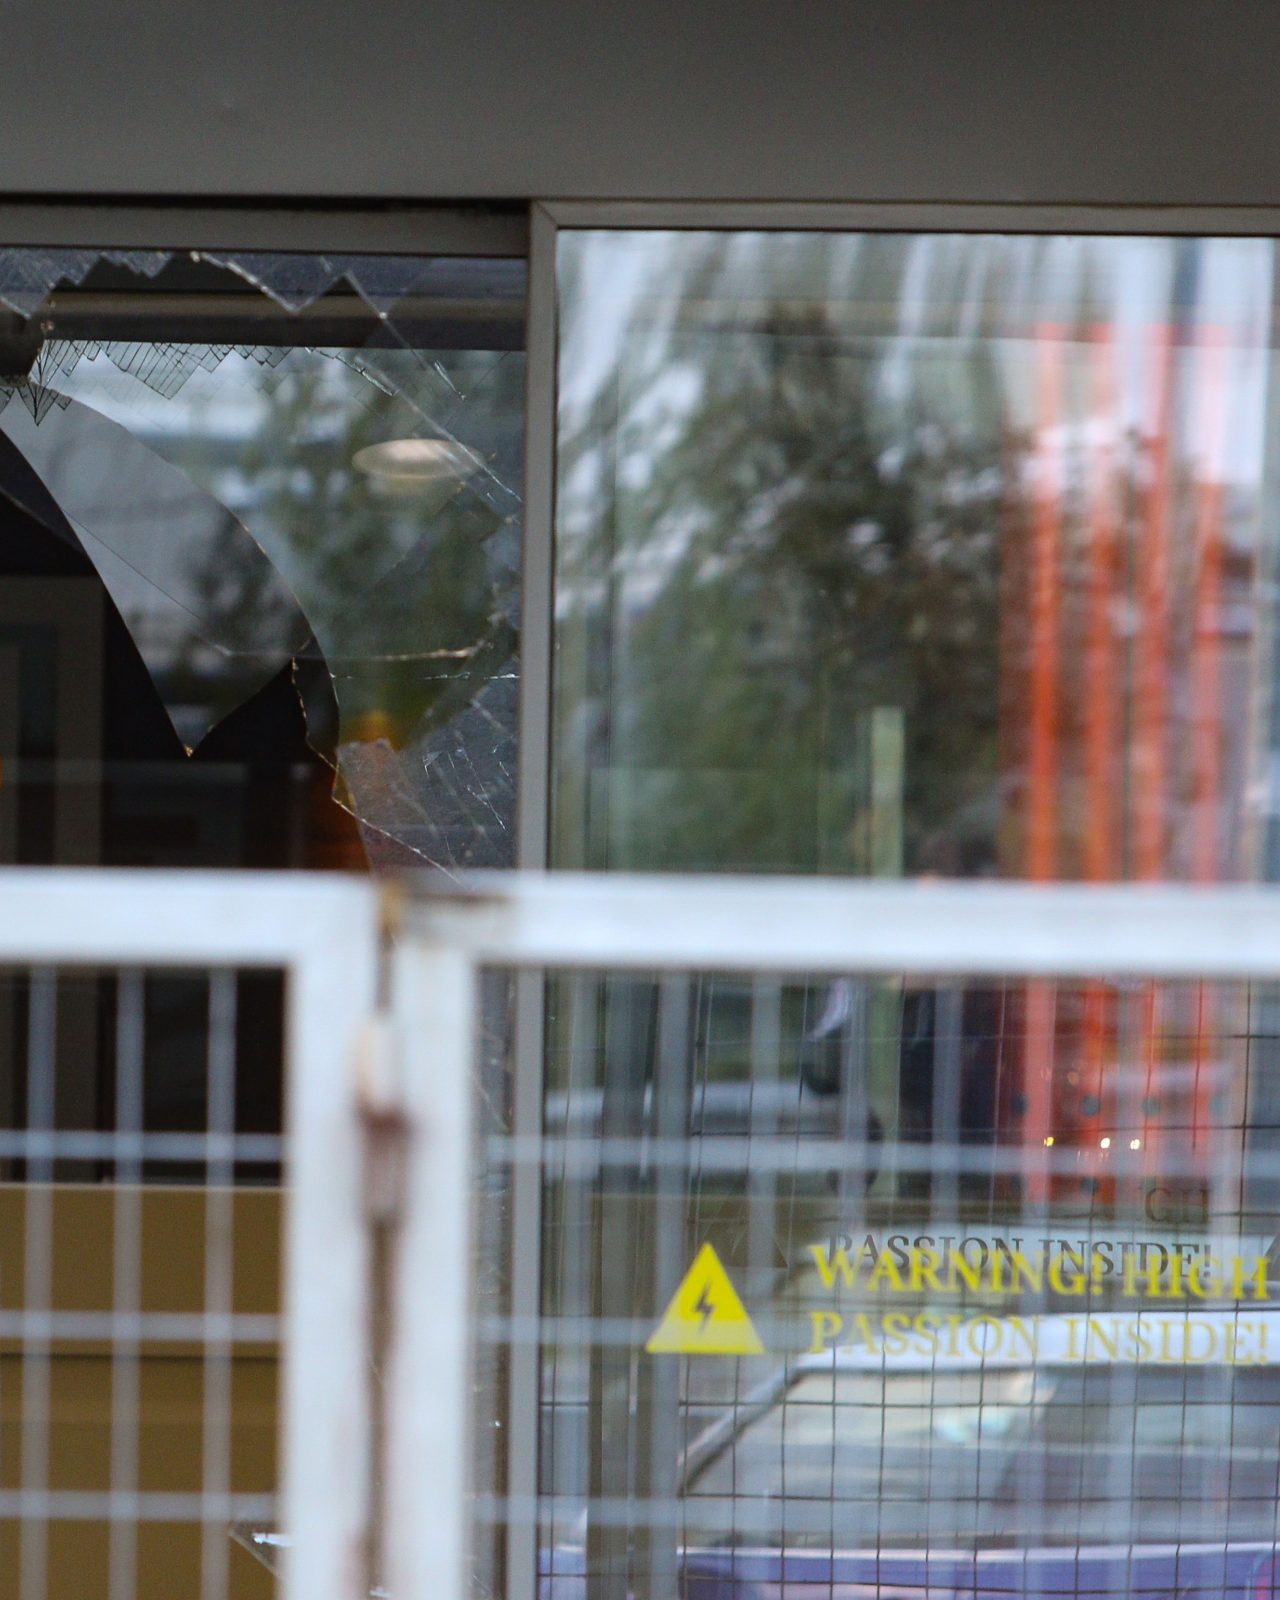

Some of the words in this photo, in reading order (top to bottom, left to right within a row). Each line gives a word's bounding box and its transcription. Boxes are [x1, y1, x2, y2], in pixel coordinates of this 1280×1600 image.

[810, 1245, 1103, 1296] WARNING!
[1122, 1252, 1273, 1301] HIGH
[809, 1310, 1042, 1361] PASSION
[1065, 1317, 1269, 1366] INSIDE!
